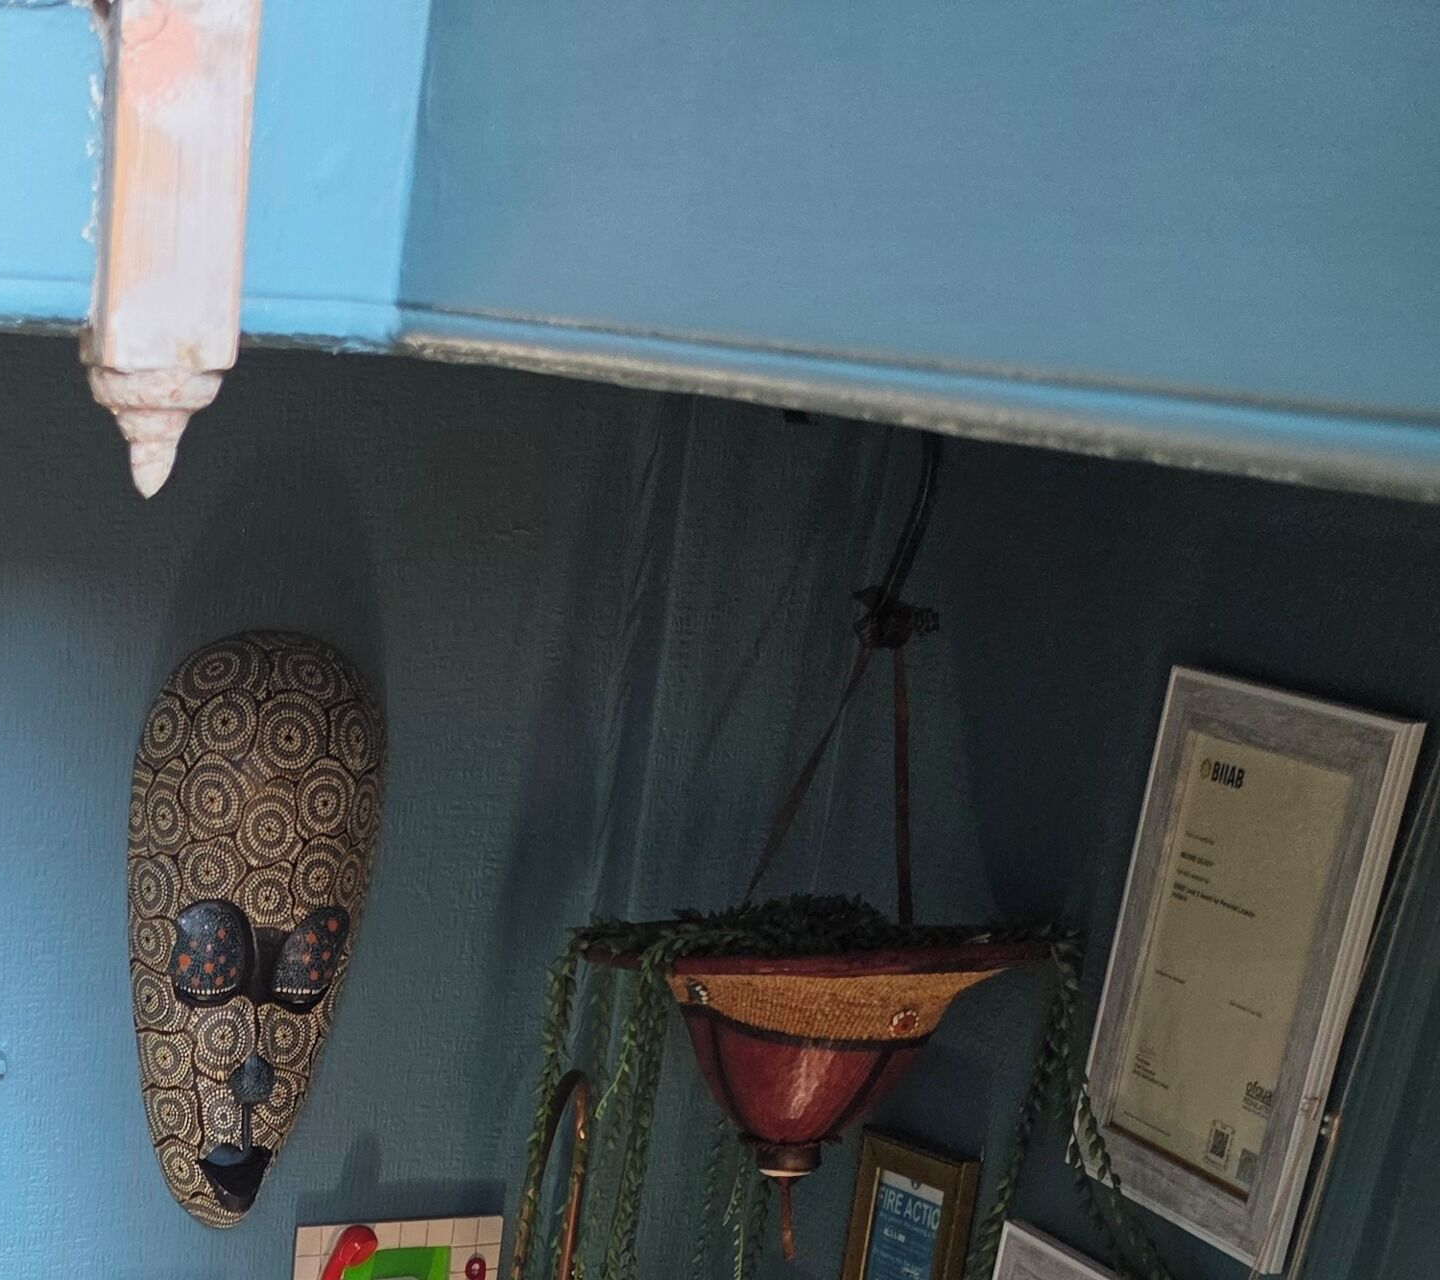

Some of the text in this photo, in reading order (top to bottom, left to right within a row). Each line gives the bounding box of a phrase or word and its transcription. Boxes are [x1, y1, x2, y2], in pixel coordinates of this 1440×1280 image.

[1212, 761, 1245, 789] BIIAB
[1246, 1081, 1272, 1101] ofqua
[879, 1187, 903, 1215] FIRE
[904, 1196, 941, 1231] ACTIO
